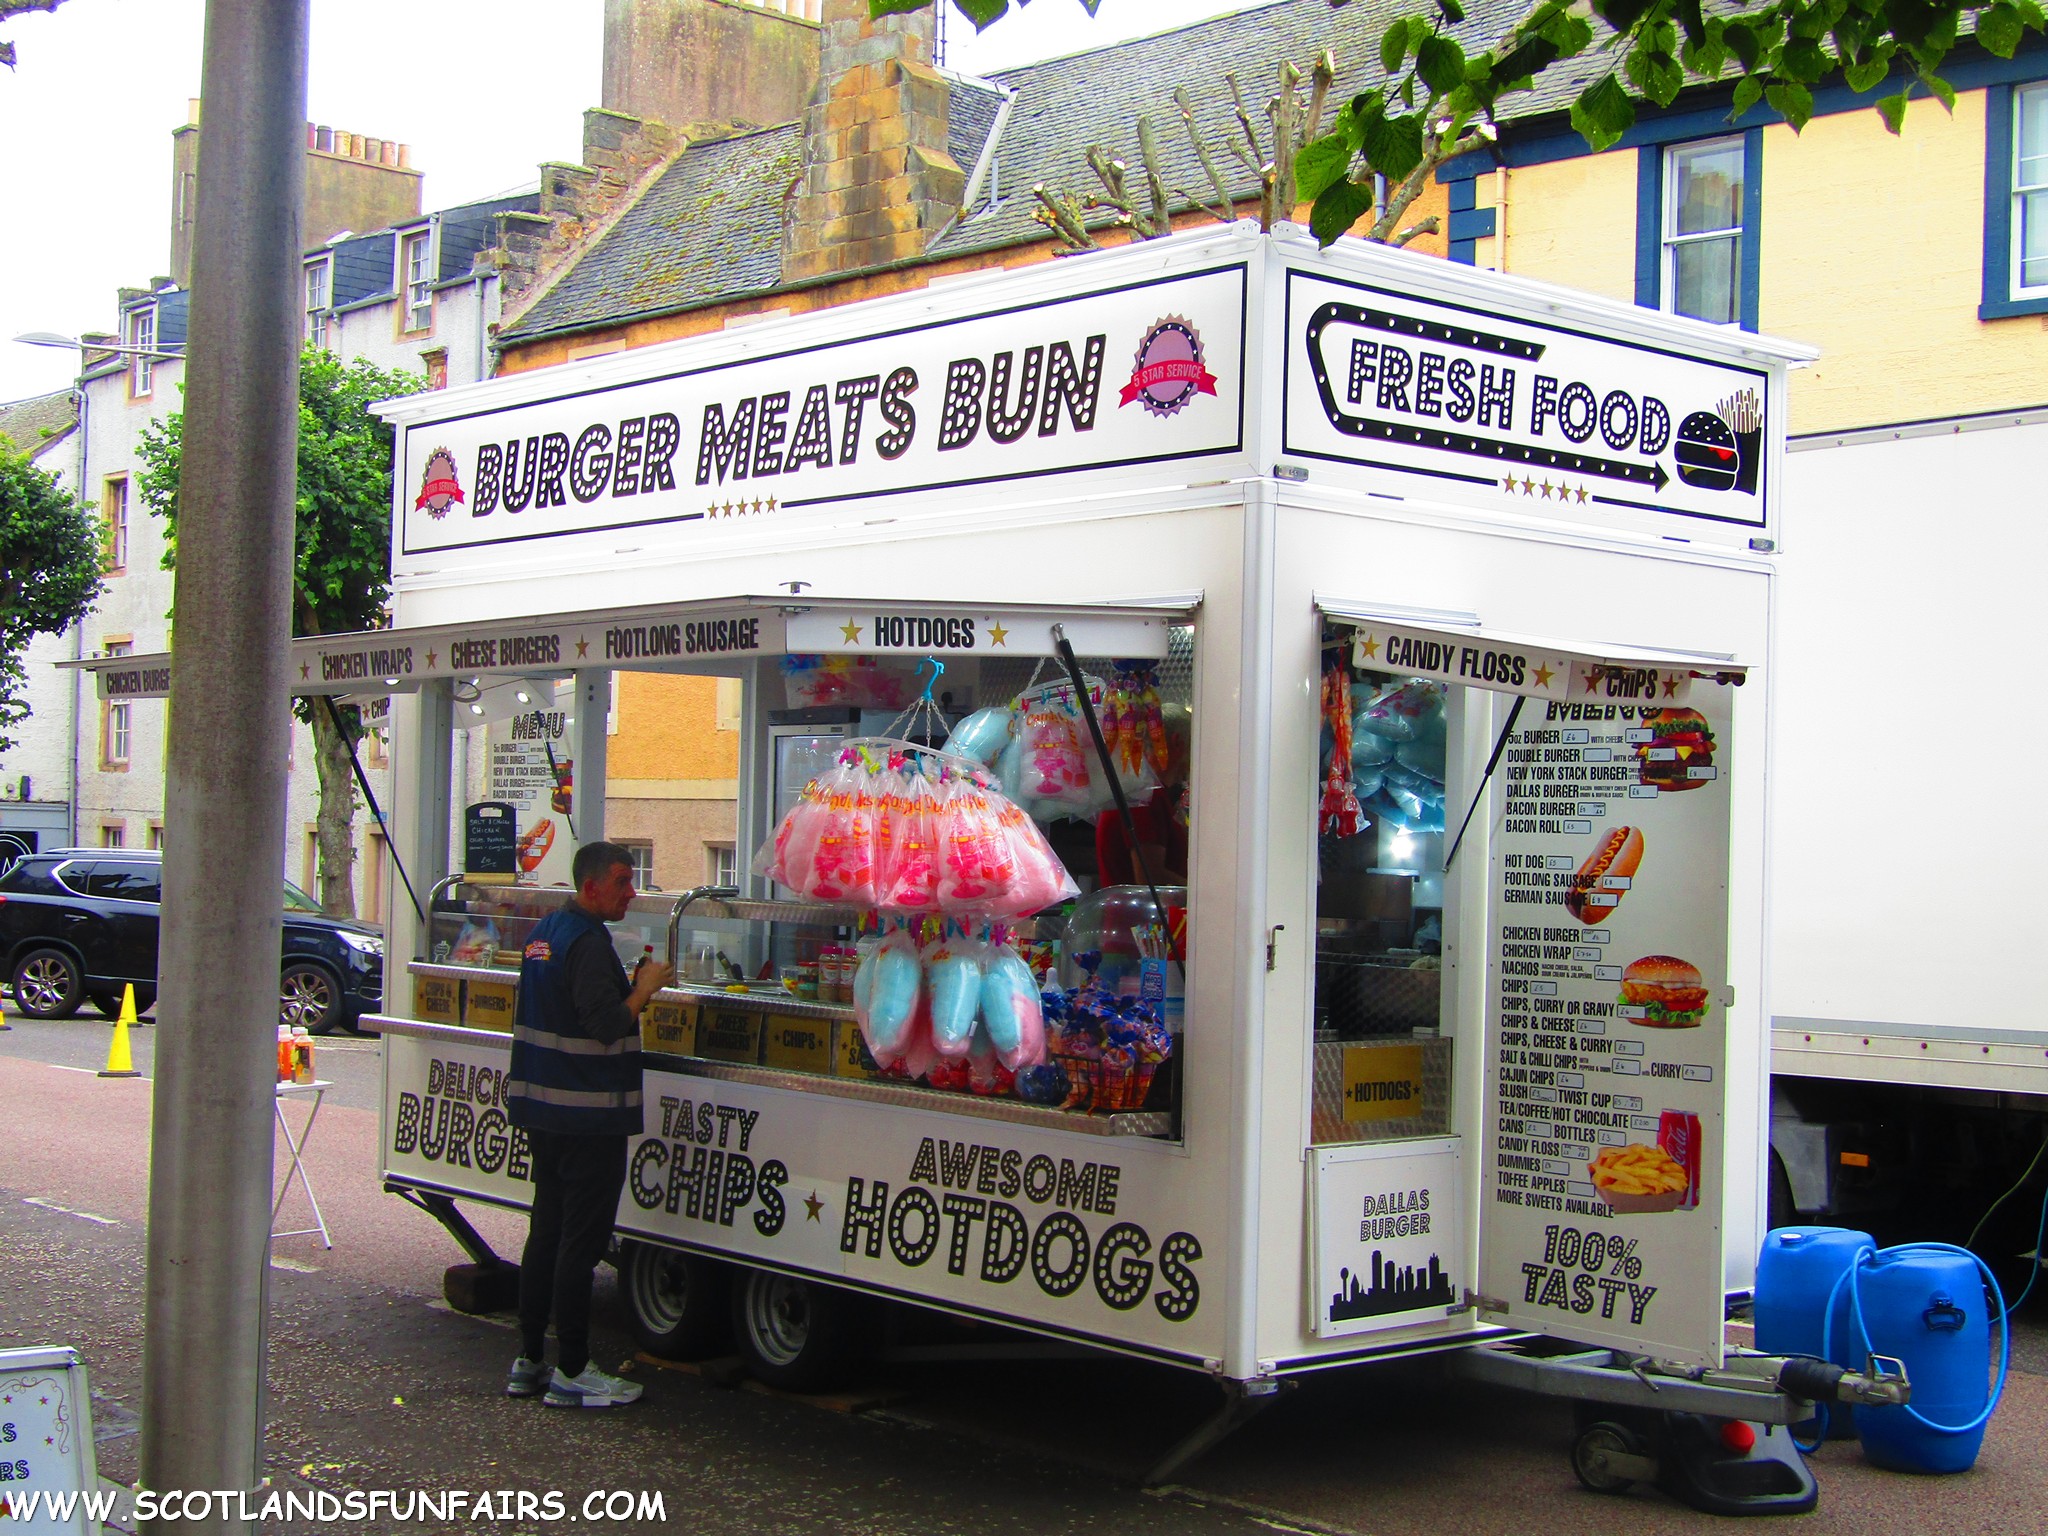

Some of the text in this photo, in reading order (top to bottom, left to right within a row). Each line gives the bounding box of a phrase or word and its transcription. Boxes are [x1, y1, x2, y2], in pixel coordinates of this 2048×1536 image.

[1133, 363, 1202, 387] 5 STAR SERVICE
[1347, 338, 1671, 456] FRESH FOOD
[472, 332, 1107, 518] BURGER MEATS BUN
[605, 616, 760, 659] FOOTLONG SAUSAGE
[874, 616, 976, 648] HOTDOGS
[451, 634, 560, 668] CHEESE BURGERS
[1386, 635, 1526, 687] CANDY FLOSS
[322, 646, 413, 681] CHICKEN WRAPS
[106, 671, 142, 695] CHICKEN
[1605, 668, 1657, 700] CHIPS
[1524, 731, 1560, 744] BURGER
[1605, 736, 1624, 744] CHEESE
[1508, 749, 1580, 763] DOUBLE BURGER
[1507, 767, 1528, 780] NEW
[1531, 767, 1555, 780] YORK
[1558, 767, 1587, 780] STACK
[1590, 767, 1628, 780] BURGER
[1506, 785, 1579, 798] DALLAS BURGER
[1506, 802, 1575, 816] BACON BURGER
[1506, 819, 1561, 834] BACON ROLL
[1505, 854, 1544, 869] HOT DOG
[1504, 872, 1550, 887] FOOTLONG
[1553, 873, 1596, 889] SAUSAGE
[1504, 889, 1543, 904] GERMAN
[1502, 926, 1580, 943] CHICKEN BURGER
[1502, 944, 1572, 960] CHICKEN WRAP
[1502, 961, 1539, 976] NACHOS
[1502, 979, 1529, 994] CHIPS
[474, 993, 506, 1012] BURGERS
[1501, 997, 1615, 1017] CHIPS, CURRY OR GRAVY
[653, 1006, 687, 1026] CHIPS &
[714, 1014, 749, 1033] CHEESE
[1501, 1015, 1575, 1032] CHIPS & CHEESE
[656, 1023, 683, 1043] CURRY
[707, 1030, 751, 1051] BURGERS
[782, 1029, 815, 1050] CHIPS
[1501, 1032, 1613, 1053] CHIPS, CHEESE & CURRY
[1500, 1049, 1578, 1070] SALT & CHILLI CHIPS
[1500, 1067, 1555, 1085] CAJUN CHIPS
[1651, 1063, 1681, 1079] CURRY
[1354, 1080, 1411, 1102] HOTDOGS
[1499, 1083, 1528, 1099] SLUSH
[1558, 1089, 1588, 1106] TWIST
[1591, 1093, 1611, 1108] CUP
[659, 1096, 760, 1152] TASTY
[1499, 1101, 1629, 1129] TEA/COFFEE/HOT CHOCOLATE
[1499, 1119, 1524, 1134] CANS
[1554, 1124, 1596, 1143] BOTTLES
[1498, 1135, 1560, 1157] CANDY FLOSS
[1666, 1124, 1687, 1166] Cola
[1498, 1154, 1541, 1172] DUMMIES
[908, 1136, 1121, 1216] AWESOME
[1498, 1171, 1566, 1194] TOFFEE APPLES
[629, 1138, 789, 1237] CHIPS
[1363, 1189, 1430, 1217] DALLAS
[1497, 1189, 1615, 1219] MORE SWEETS AVAILABLE
[1360, 1213, 1431, 1242] BURGER
[840, 1176, 1203, 1323] HOTDOGS
[1544, 1225, 1643, 1279] 100%
[1521, 1263, 1658, 1325] TASTY
